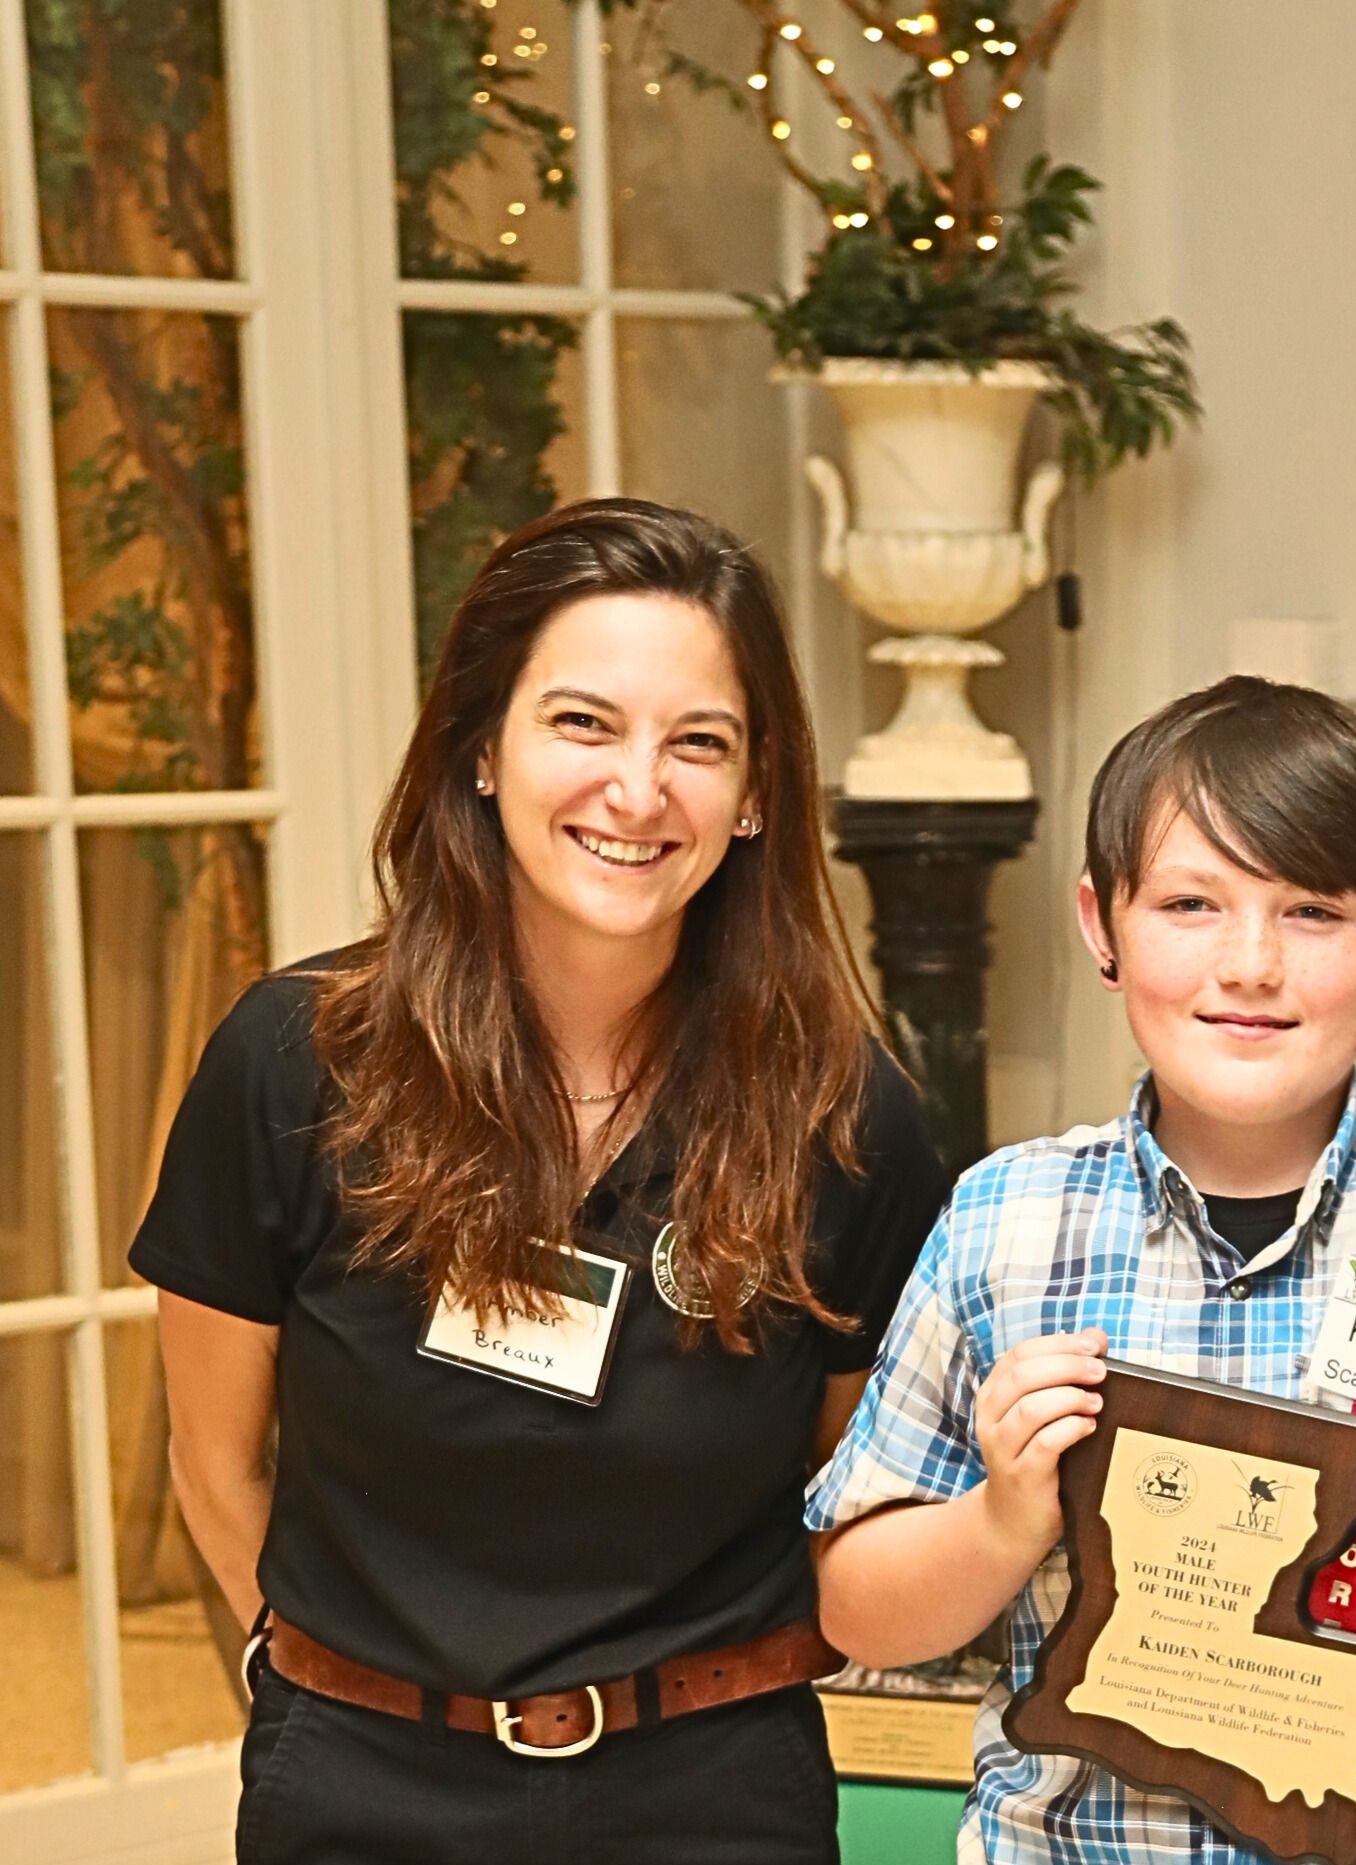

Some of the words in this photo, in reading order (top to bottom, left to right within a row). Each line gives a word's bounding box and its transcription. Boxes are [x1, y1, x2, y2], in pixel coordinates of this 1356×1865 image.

[472, 1329, 554, 1368] Breaux
[1151, 1455, 1189, 1470] LOUISIANA
[1235, 1510, 1274, 1532] LWF
[1180, 1535, 1216, 1552] 2024
[1174, 1552, 1216, 1571] MALE
[1132, 1561, 1185, 1582] YOUTH
[1189, 1573, 1252, 1597] HUNTER
[1138, 1581, 1159, 1595] OF
[1163, 1586, 1194, 1603] THE
[1199, 1593, 1238, 1612] YEAR
[1150, 1609, 1203, 1629] Presented
[1206, 1621, 1220, 1632] To
[1138, 1635, 1200, 1660] KAIDEN
[1205, 1650, 1322, 1687] SCARBOROUGH
[1106, 1652, 1118, 1663] In
[1120, 1655, 1179, 1676] Recognition
[1181, 1669, 1197, 1681] Of
[1197, 1672, 1221, 1685] Your
[1223, 1678, 1247, 1690] Deer
[1249, 1683, 1291, 1702] Hunting
[1295, 1693, 1344, 1712] Adventure
[1099, 1675, 1152, 1695] Louisiana
[1156, 1687, 1221, 1711] Department
[1222, 1703, 1236, 1714] of
[1238, 1704, 1280, 1723] Wildlife
[1283, 1715, 1292, 1726] &
[1297, 1717, 1345, 1737] Fisheries
[1126, 1700, 1148, 1710] and
[1150, 1702, 1203, 1722] Louisiana
[1207, 1713, 1250, 1732] Wildlife
[1252, 1723, 1312, 1746] Federation
